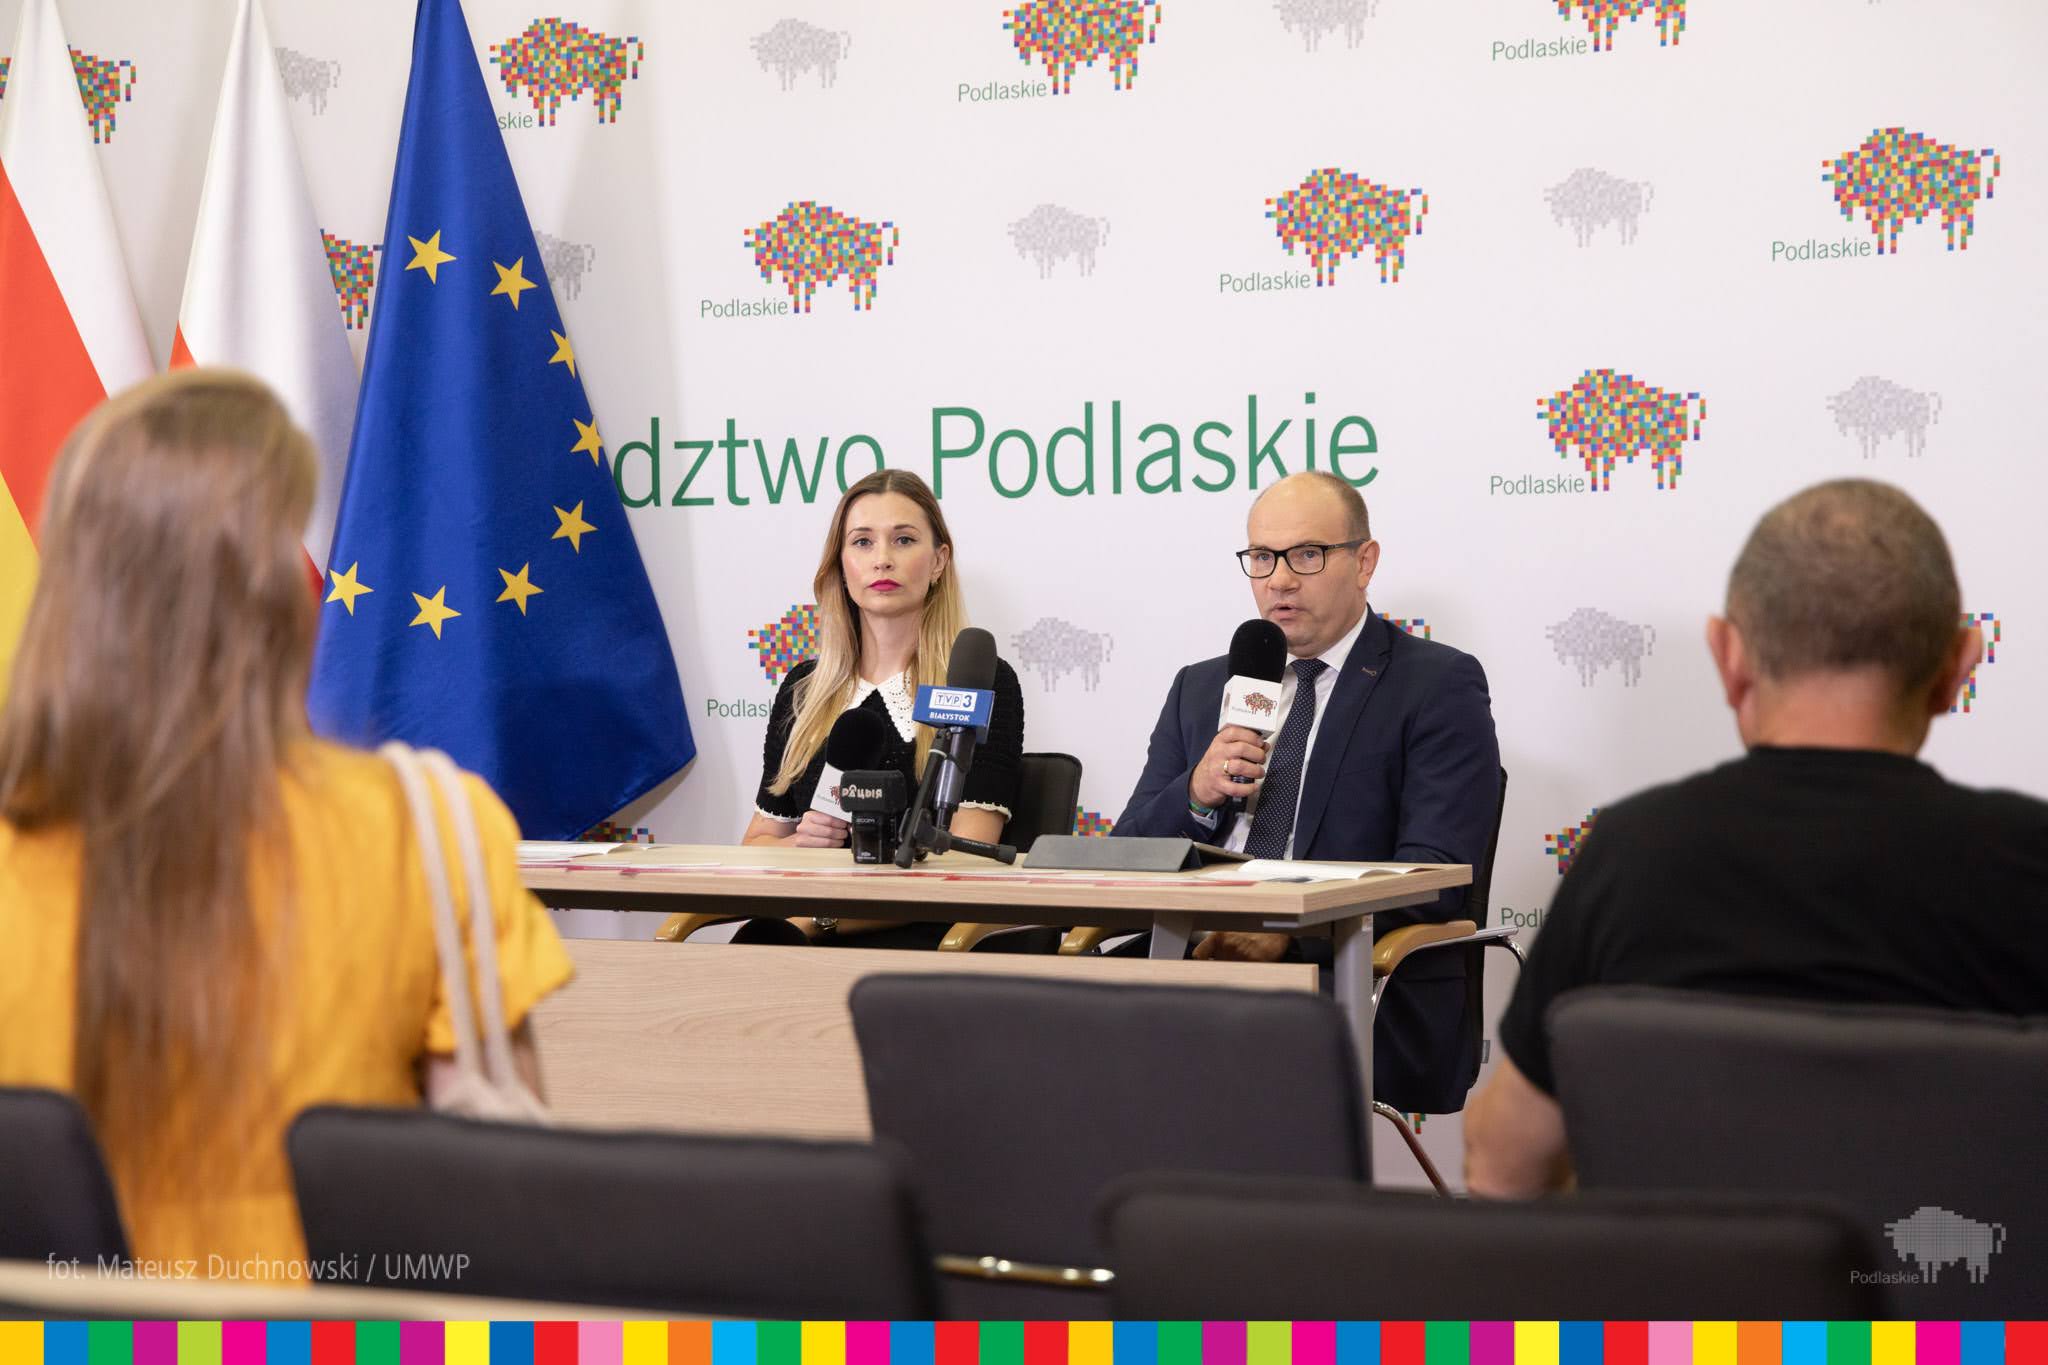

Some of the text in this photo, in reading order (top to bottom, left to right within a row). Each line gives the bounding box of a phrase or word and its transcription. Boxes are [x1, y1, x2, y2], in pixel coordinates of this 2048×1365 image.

[1492, 36, 1587, 61] Podlaskie
[958, 79, 1047, 102] Podlaskie
[498, 111, 533, 129] skie
[1771, 237, 1871, 261] Podlaskie
[1220, 270, 1311, 293] Podlaskie
[701, 297, 788, 318] Podlaskie
[613, 391, 1379, 508] dztwo Podlaskie
[1490, 473, 1585, 495] Podlaskie
[929, 711, 970, 722] BIAŁYSTOK
[1501, 907, 1543, 928] Podl
